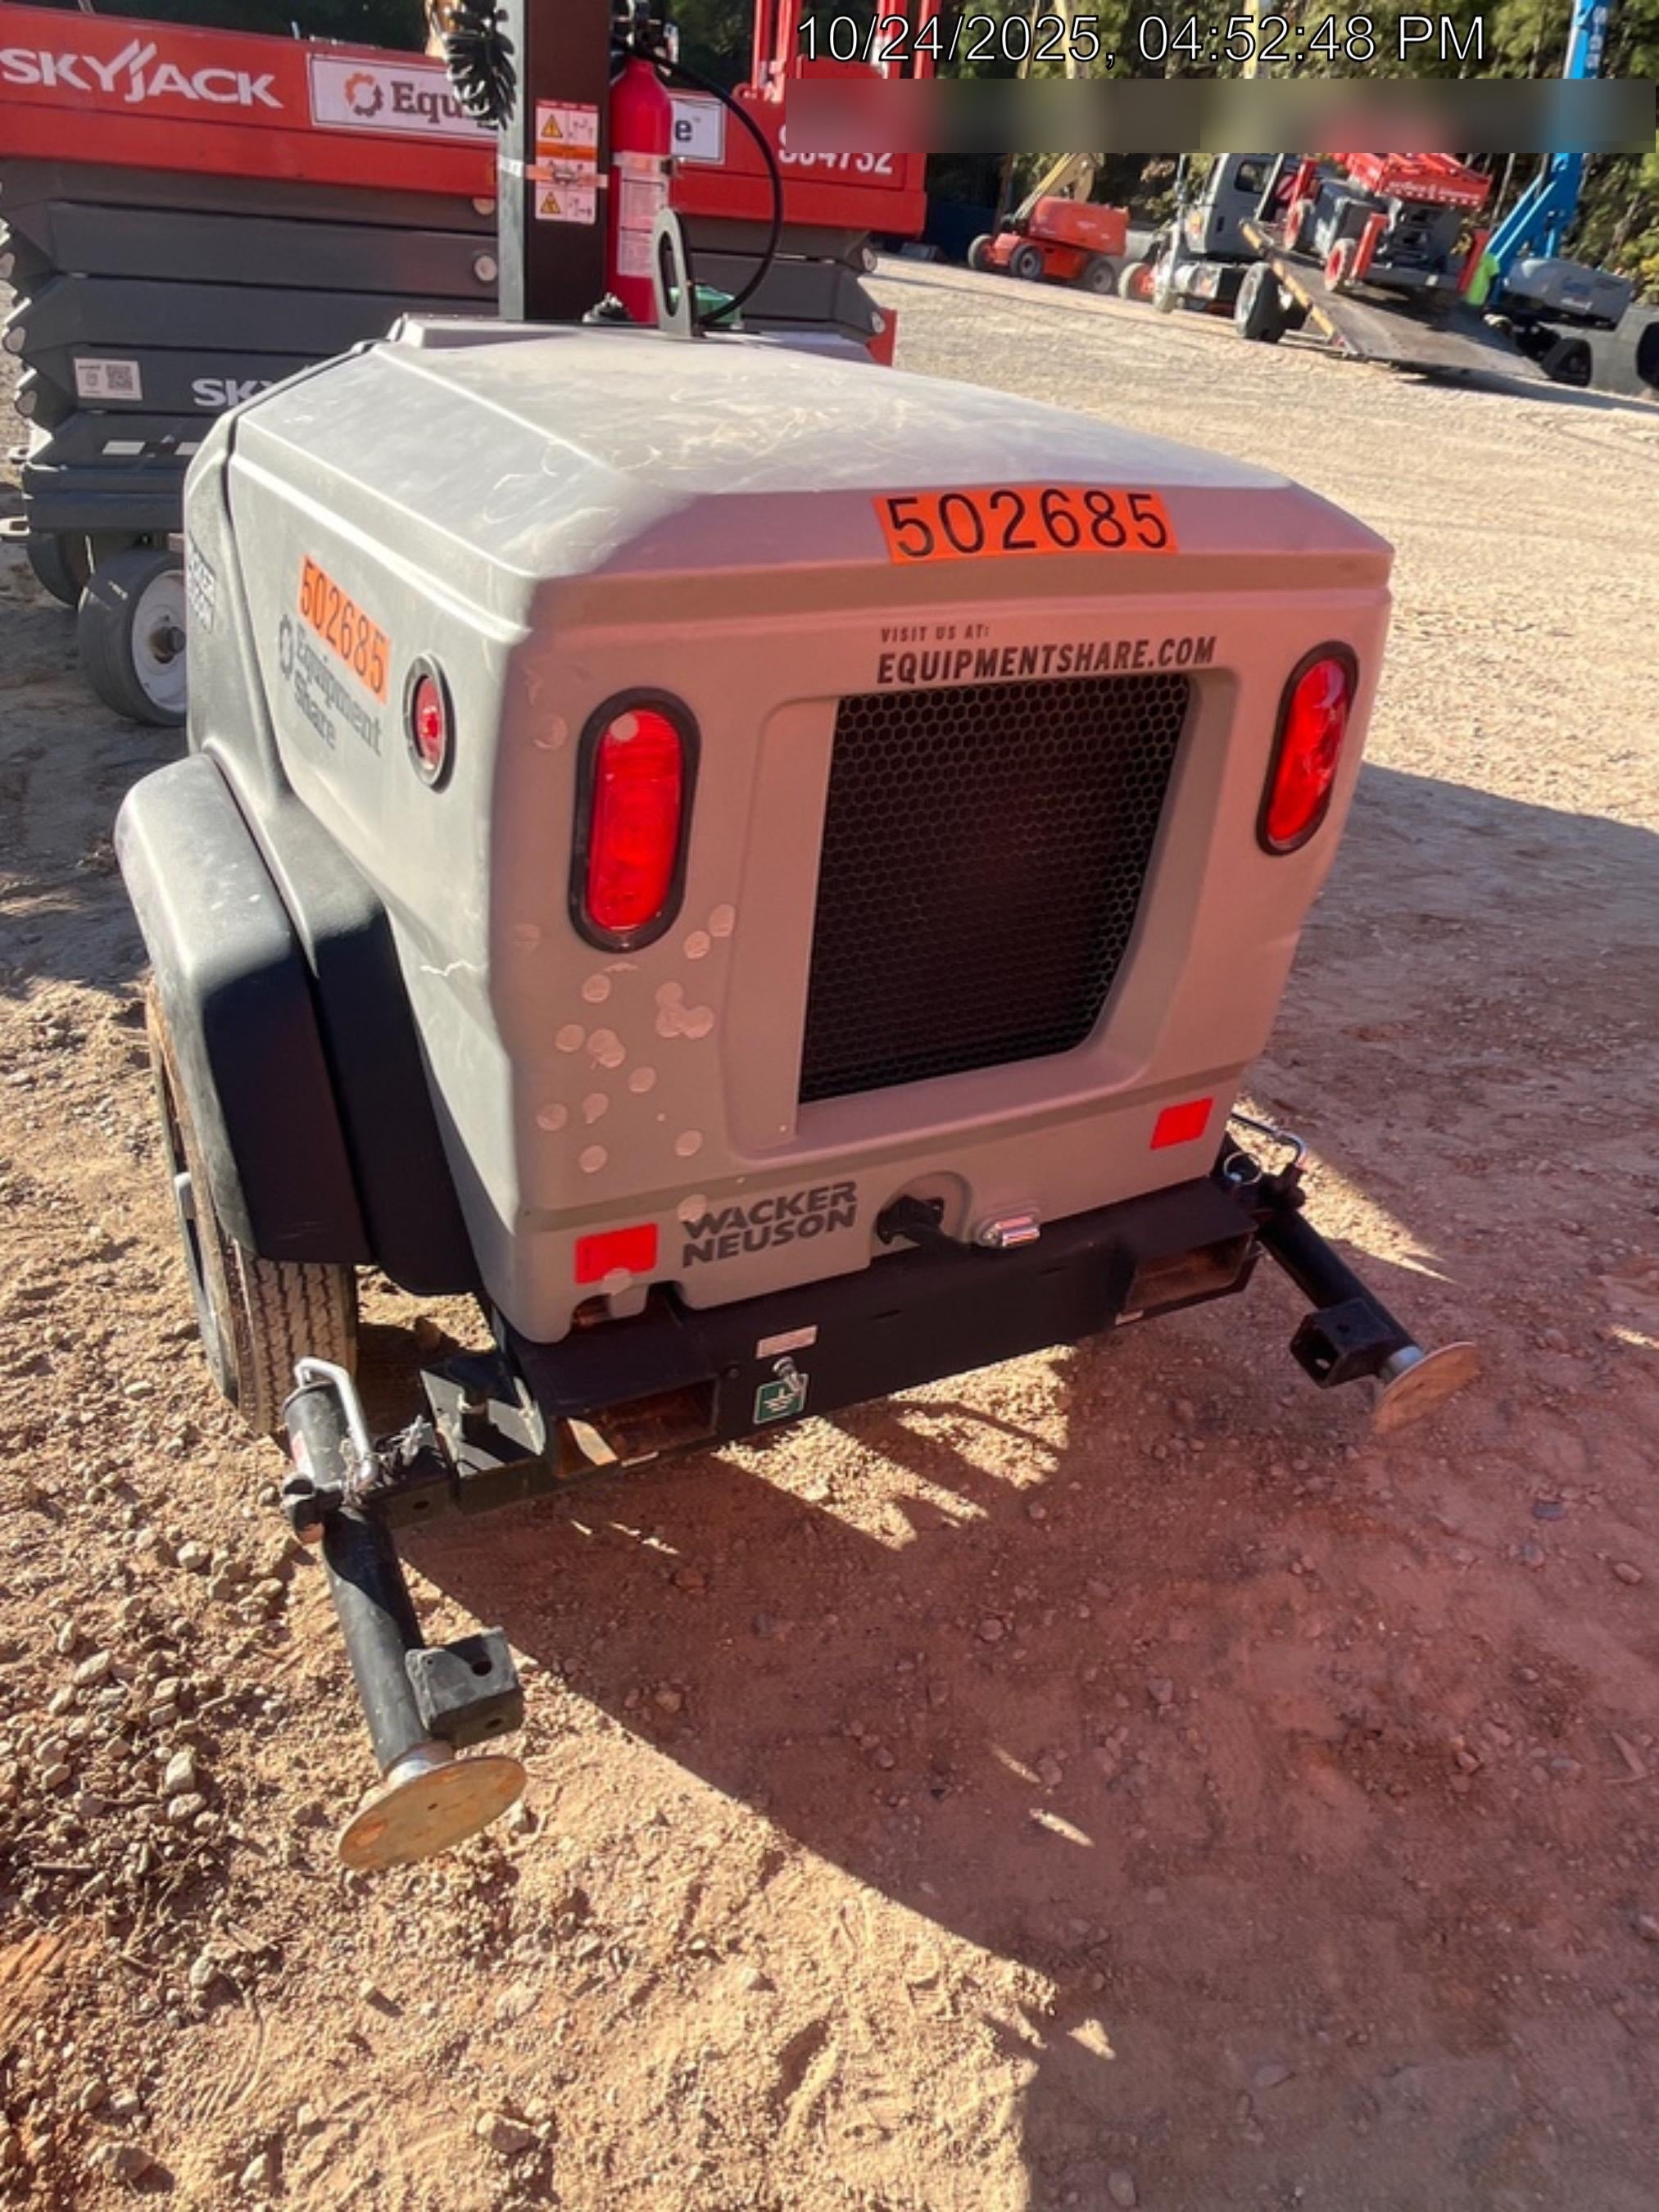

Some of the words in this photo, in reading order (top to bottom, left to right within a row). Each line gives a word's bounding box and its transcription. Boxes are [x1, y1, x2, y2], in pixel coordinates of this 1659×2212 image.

[0, 39, 284, 109] SKYJACK
[192, 378, 273, 407] SK
[887, 489, 1167, 557] 502685
[301, 558, 385, 694] 502685
[881, 627, 927, 642] VISIT
[936, 625, 956, 640] US
[964, 623, 990, 639] AT:
[296, 620, 382, 757] Equipment
[877, 636, 1217, 685] EQUIPMENTSHARE.COM
[294, 668, 337, 750] Share
[682, 1181, 858, 1240] WACKER
[682, 1204, 858, 1269] NEUSON
